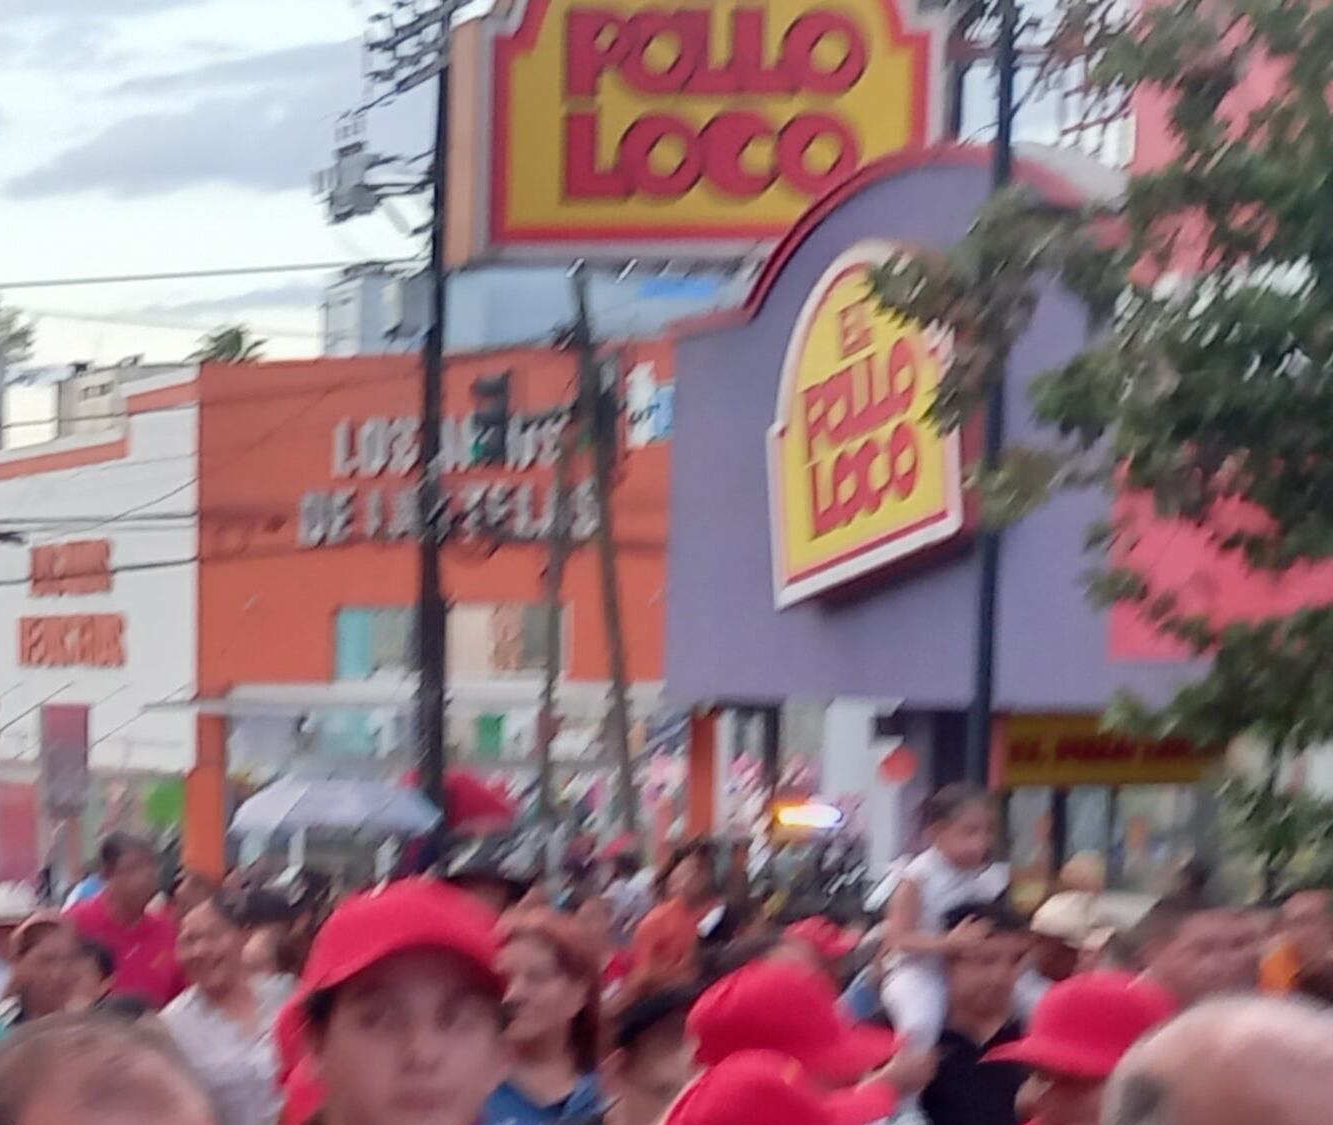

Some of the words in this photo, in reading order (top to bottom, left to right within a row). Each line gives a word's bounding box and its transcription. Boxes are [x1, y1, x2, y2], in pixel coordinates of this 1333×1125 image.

[565, 8, 868, 98] POLLO
[565, 109, 860, 199] LOCO
[839, 300, 874, 361] EL
[803, 337, 918, 447] POLLO
[810, 421, 919, 540] LOCO
